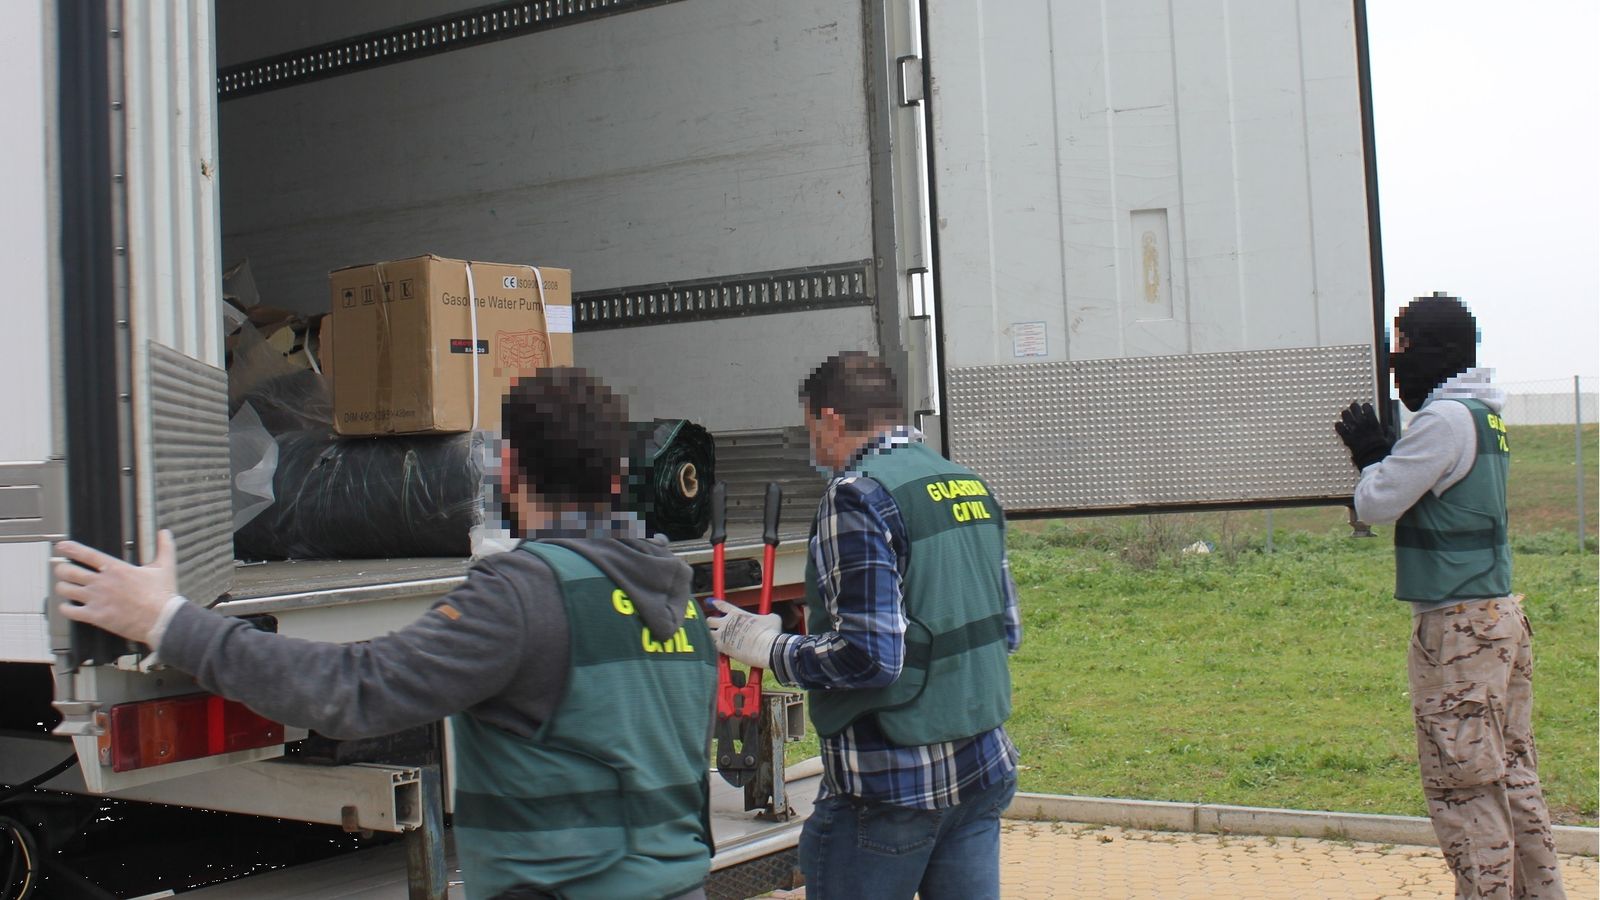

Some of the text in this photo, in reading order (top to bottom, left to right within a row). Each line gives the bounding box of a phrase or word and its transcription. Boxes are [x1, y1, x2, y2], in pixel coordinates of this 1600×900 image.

[488, 296, 517, 310] Water
[926, 479, 989, 502] GUARDIA
[952, 501, 991, 522] CIVIL
